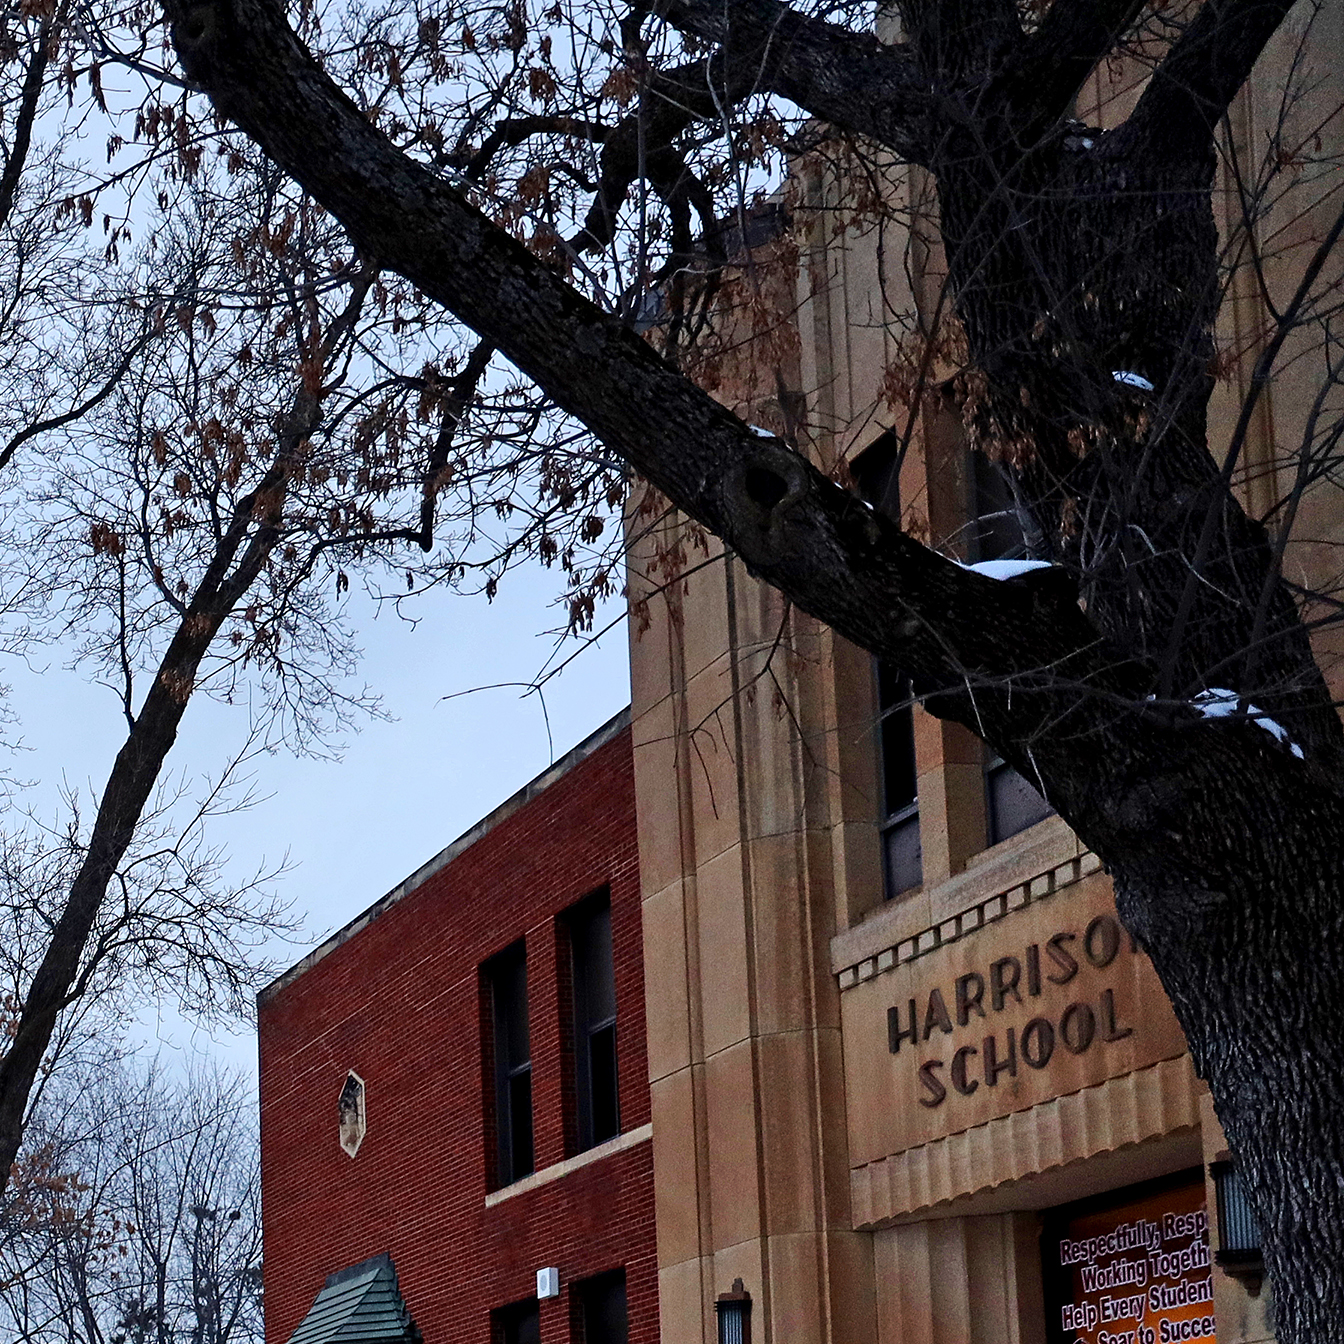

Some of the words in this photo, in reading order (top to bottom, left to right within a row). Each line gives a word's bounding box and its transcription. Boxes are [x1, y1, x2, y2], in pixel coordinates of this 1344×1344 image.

[886, 914, 1141, 1055] HARRISO
[918, 988, 1133, 1108] SCHOOL
[1060, 1219, 1160, 1265] Respectfully,
[1163, 1210, 1208, 1240] Resp
[1081, 1258, 1147, 1292] Working
[1149, 1240, 1209, 1278] Togeth
[1062, 1301, 1096, 1331] Help
[1100, 1294, 1146, 1322] Every
